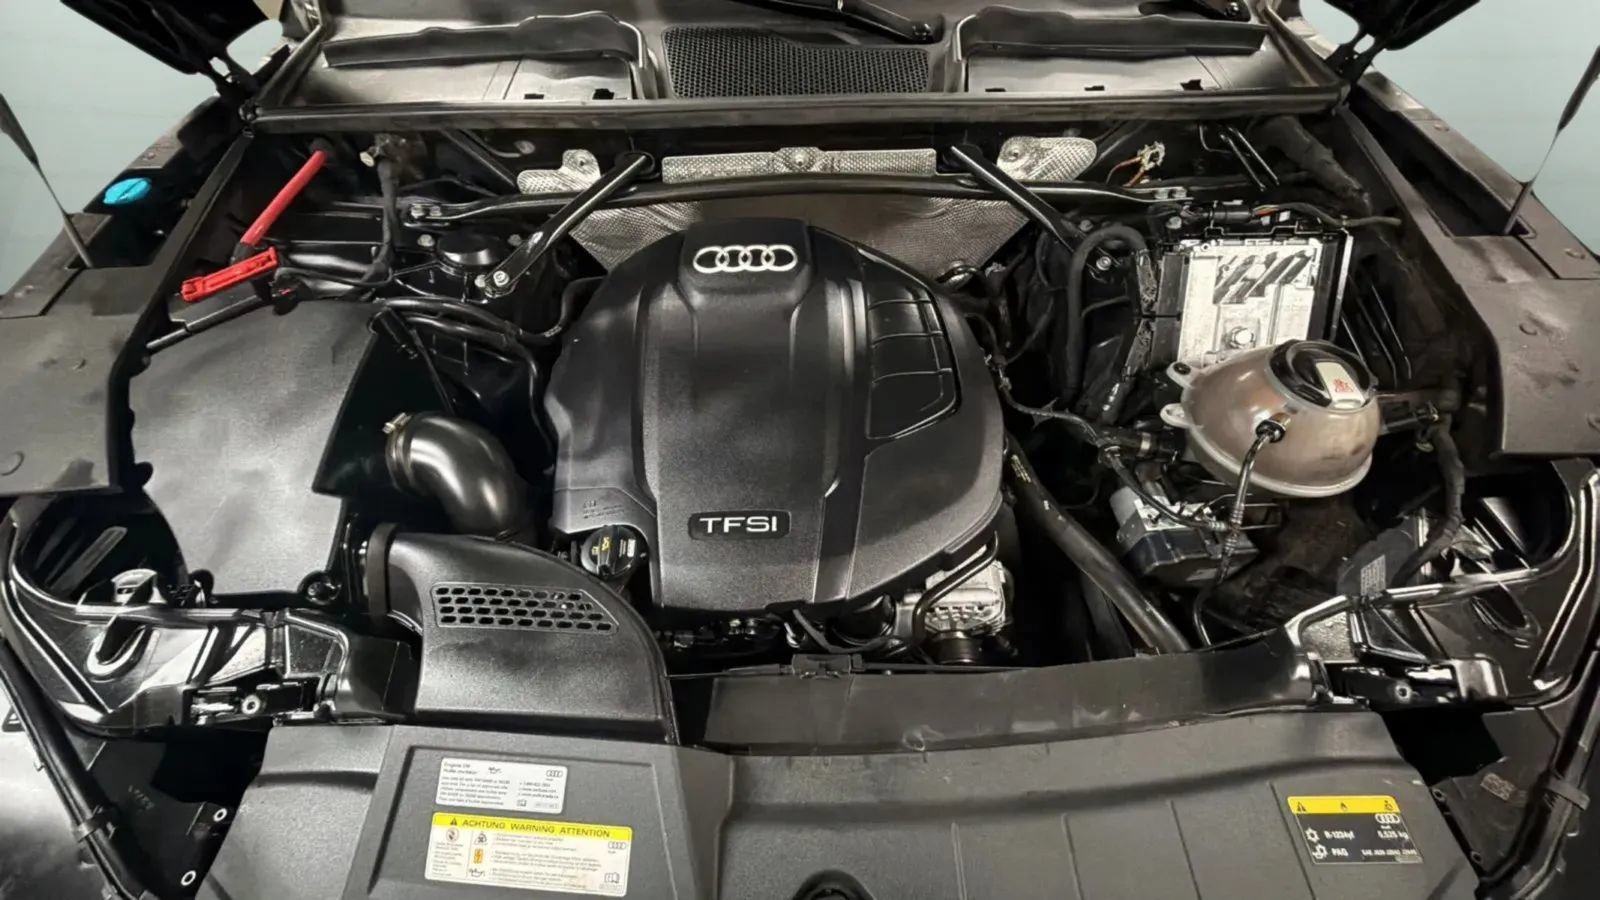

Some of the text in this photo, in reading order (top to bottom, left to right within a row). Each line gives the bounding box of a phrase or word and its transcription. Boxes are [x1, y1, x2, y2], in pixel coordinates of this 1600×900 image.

[699, 516, 777, 533] TFSI
[462, 818, 611, 838] ACHTUNG WARNING ATTENTION
